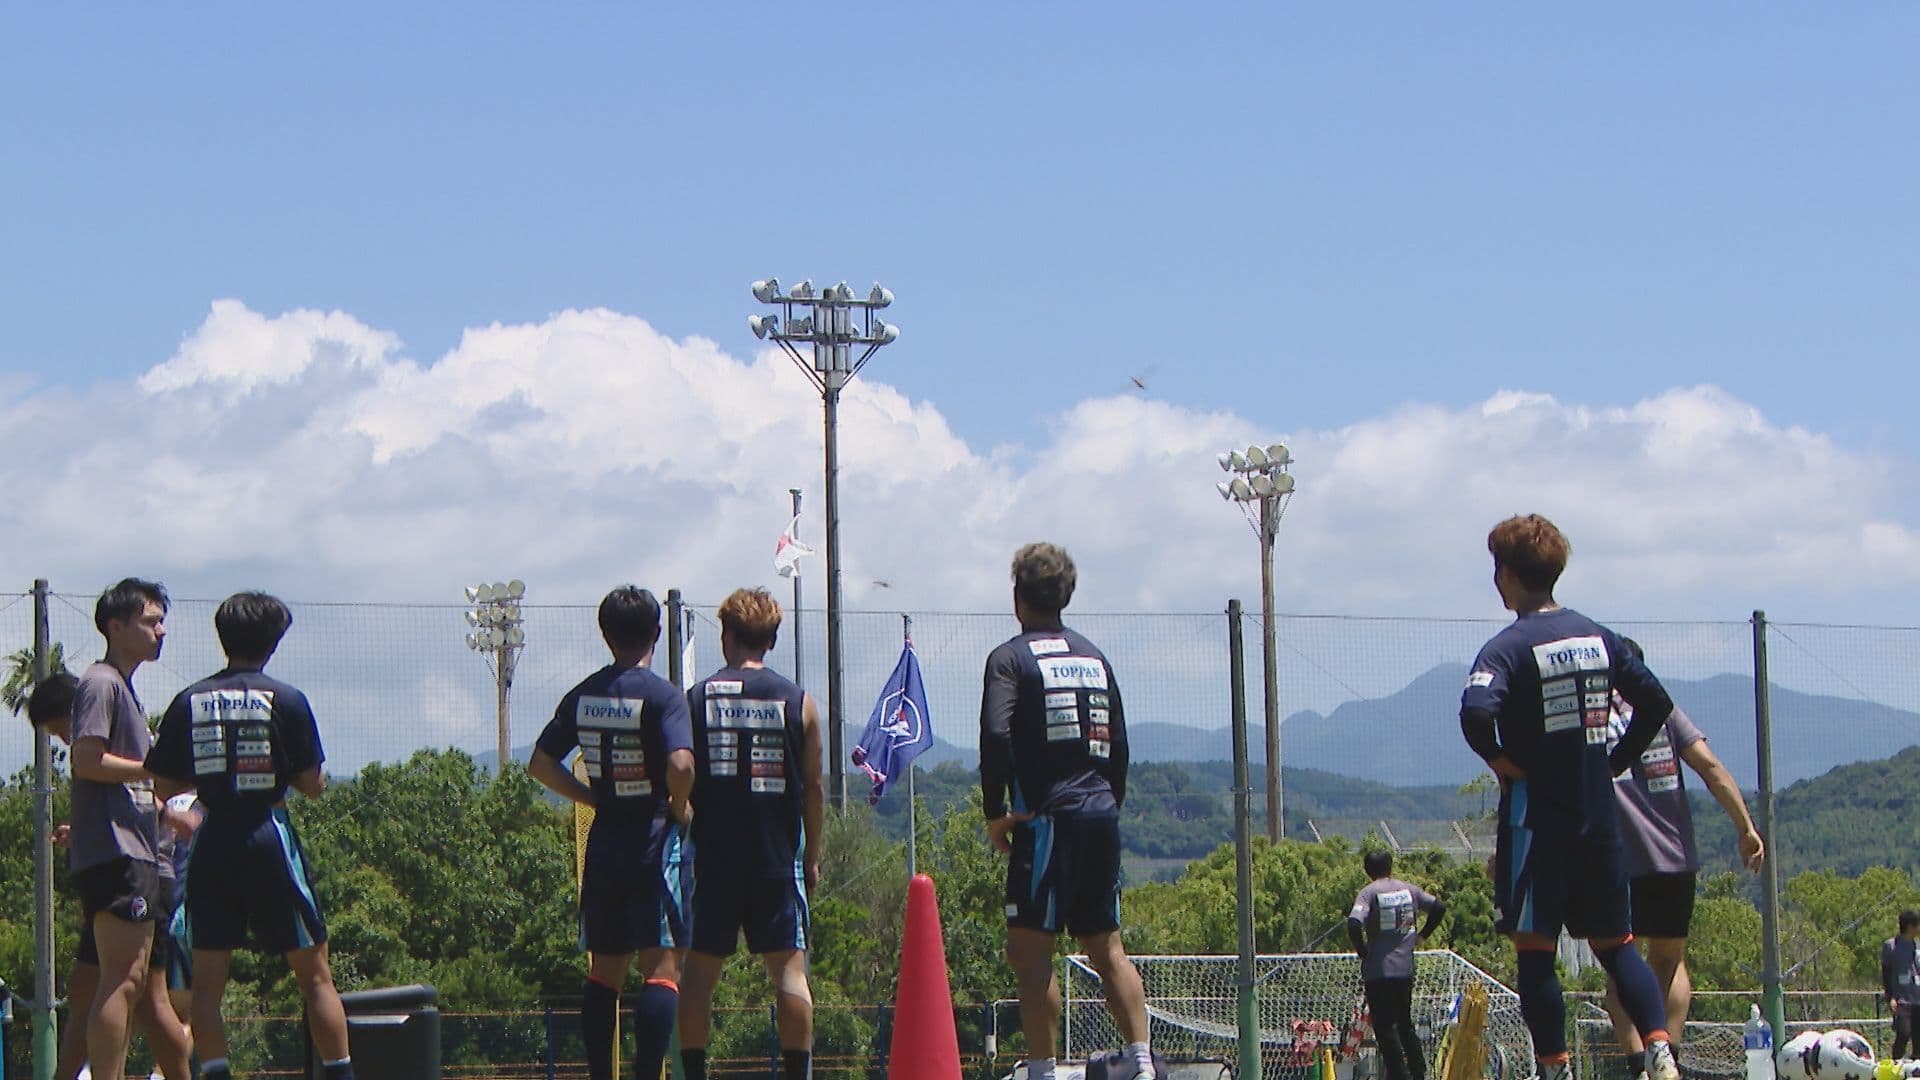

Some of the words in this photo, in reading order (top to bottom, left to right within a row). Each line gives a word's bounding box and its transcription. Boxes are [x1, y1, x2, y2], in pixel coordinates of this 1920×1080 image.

[1547, 647, 1600, 666] TOPPAN
[1051, 666, 1100, 679] TOPPAN
[201, 699, 262, 712] TOPPAN
[584, 705, 632, 718] TOPPAN
[716, 707, 775, 720] TOPPAN
